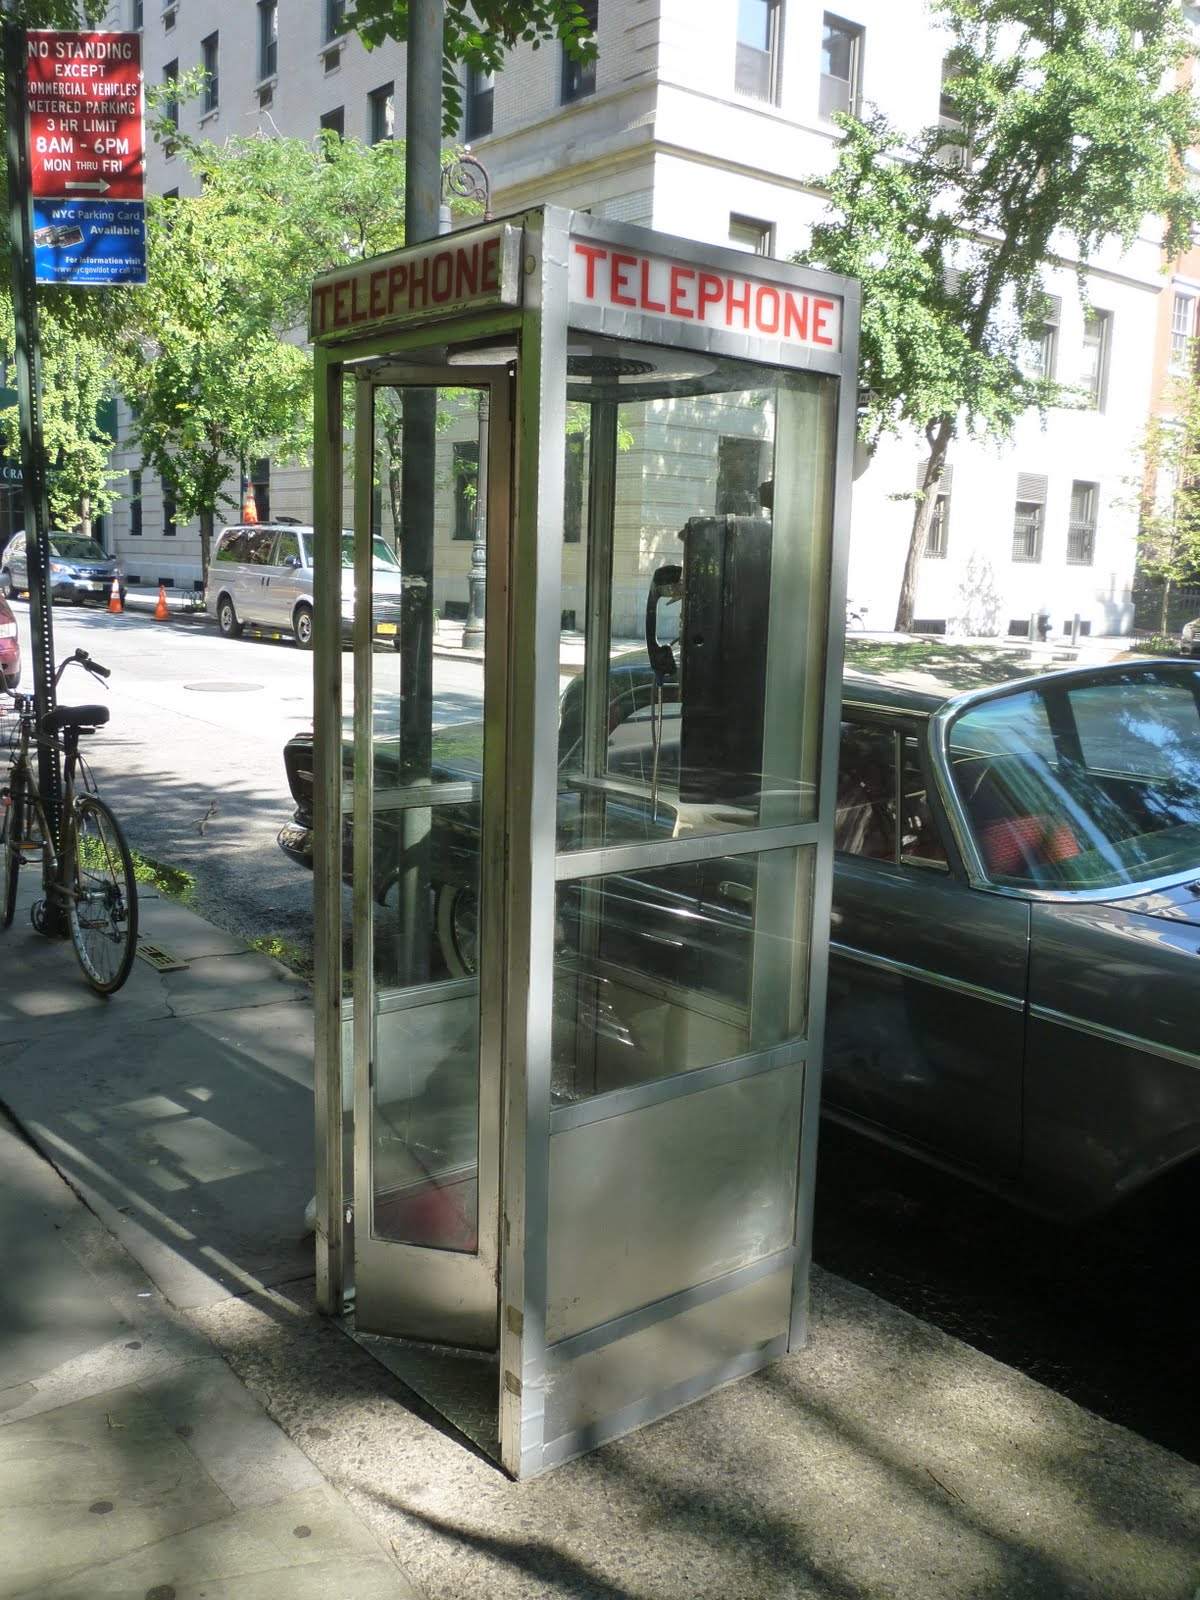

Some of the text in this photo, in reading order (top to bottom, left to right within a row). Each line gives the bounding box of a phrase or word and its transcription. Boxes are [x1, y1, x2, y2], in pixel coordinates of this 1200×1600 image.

[28, 41, 132, 59] NO STANDING
[55, 64, 106, 77] EXCEPT
[92, 83, 137, 96] VEHICLES
[28, 100, 136, 115] METERED PARKING
[47, 118, 117, 132] 3 HR LIMIT
[36, 136, 73, 153] 8AM
[94, 138, 129, 154] 6PM
[43, 158, 122, 172] MON THRU FRI
[52, 210, 140, 221] NYC Parking Card
[90, 225, 140, 235] Available
[65, 256, 141, 265] For information visit
[315, 237, 500, 330] TELEPHONE
[575, 243, 834, 346] TELEPHONE
